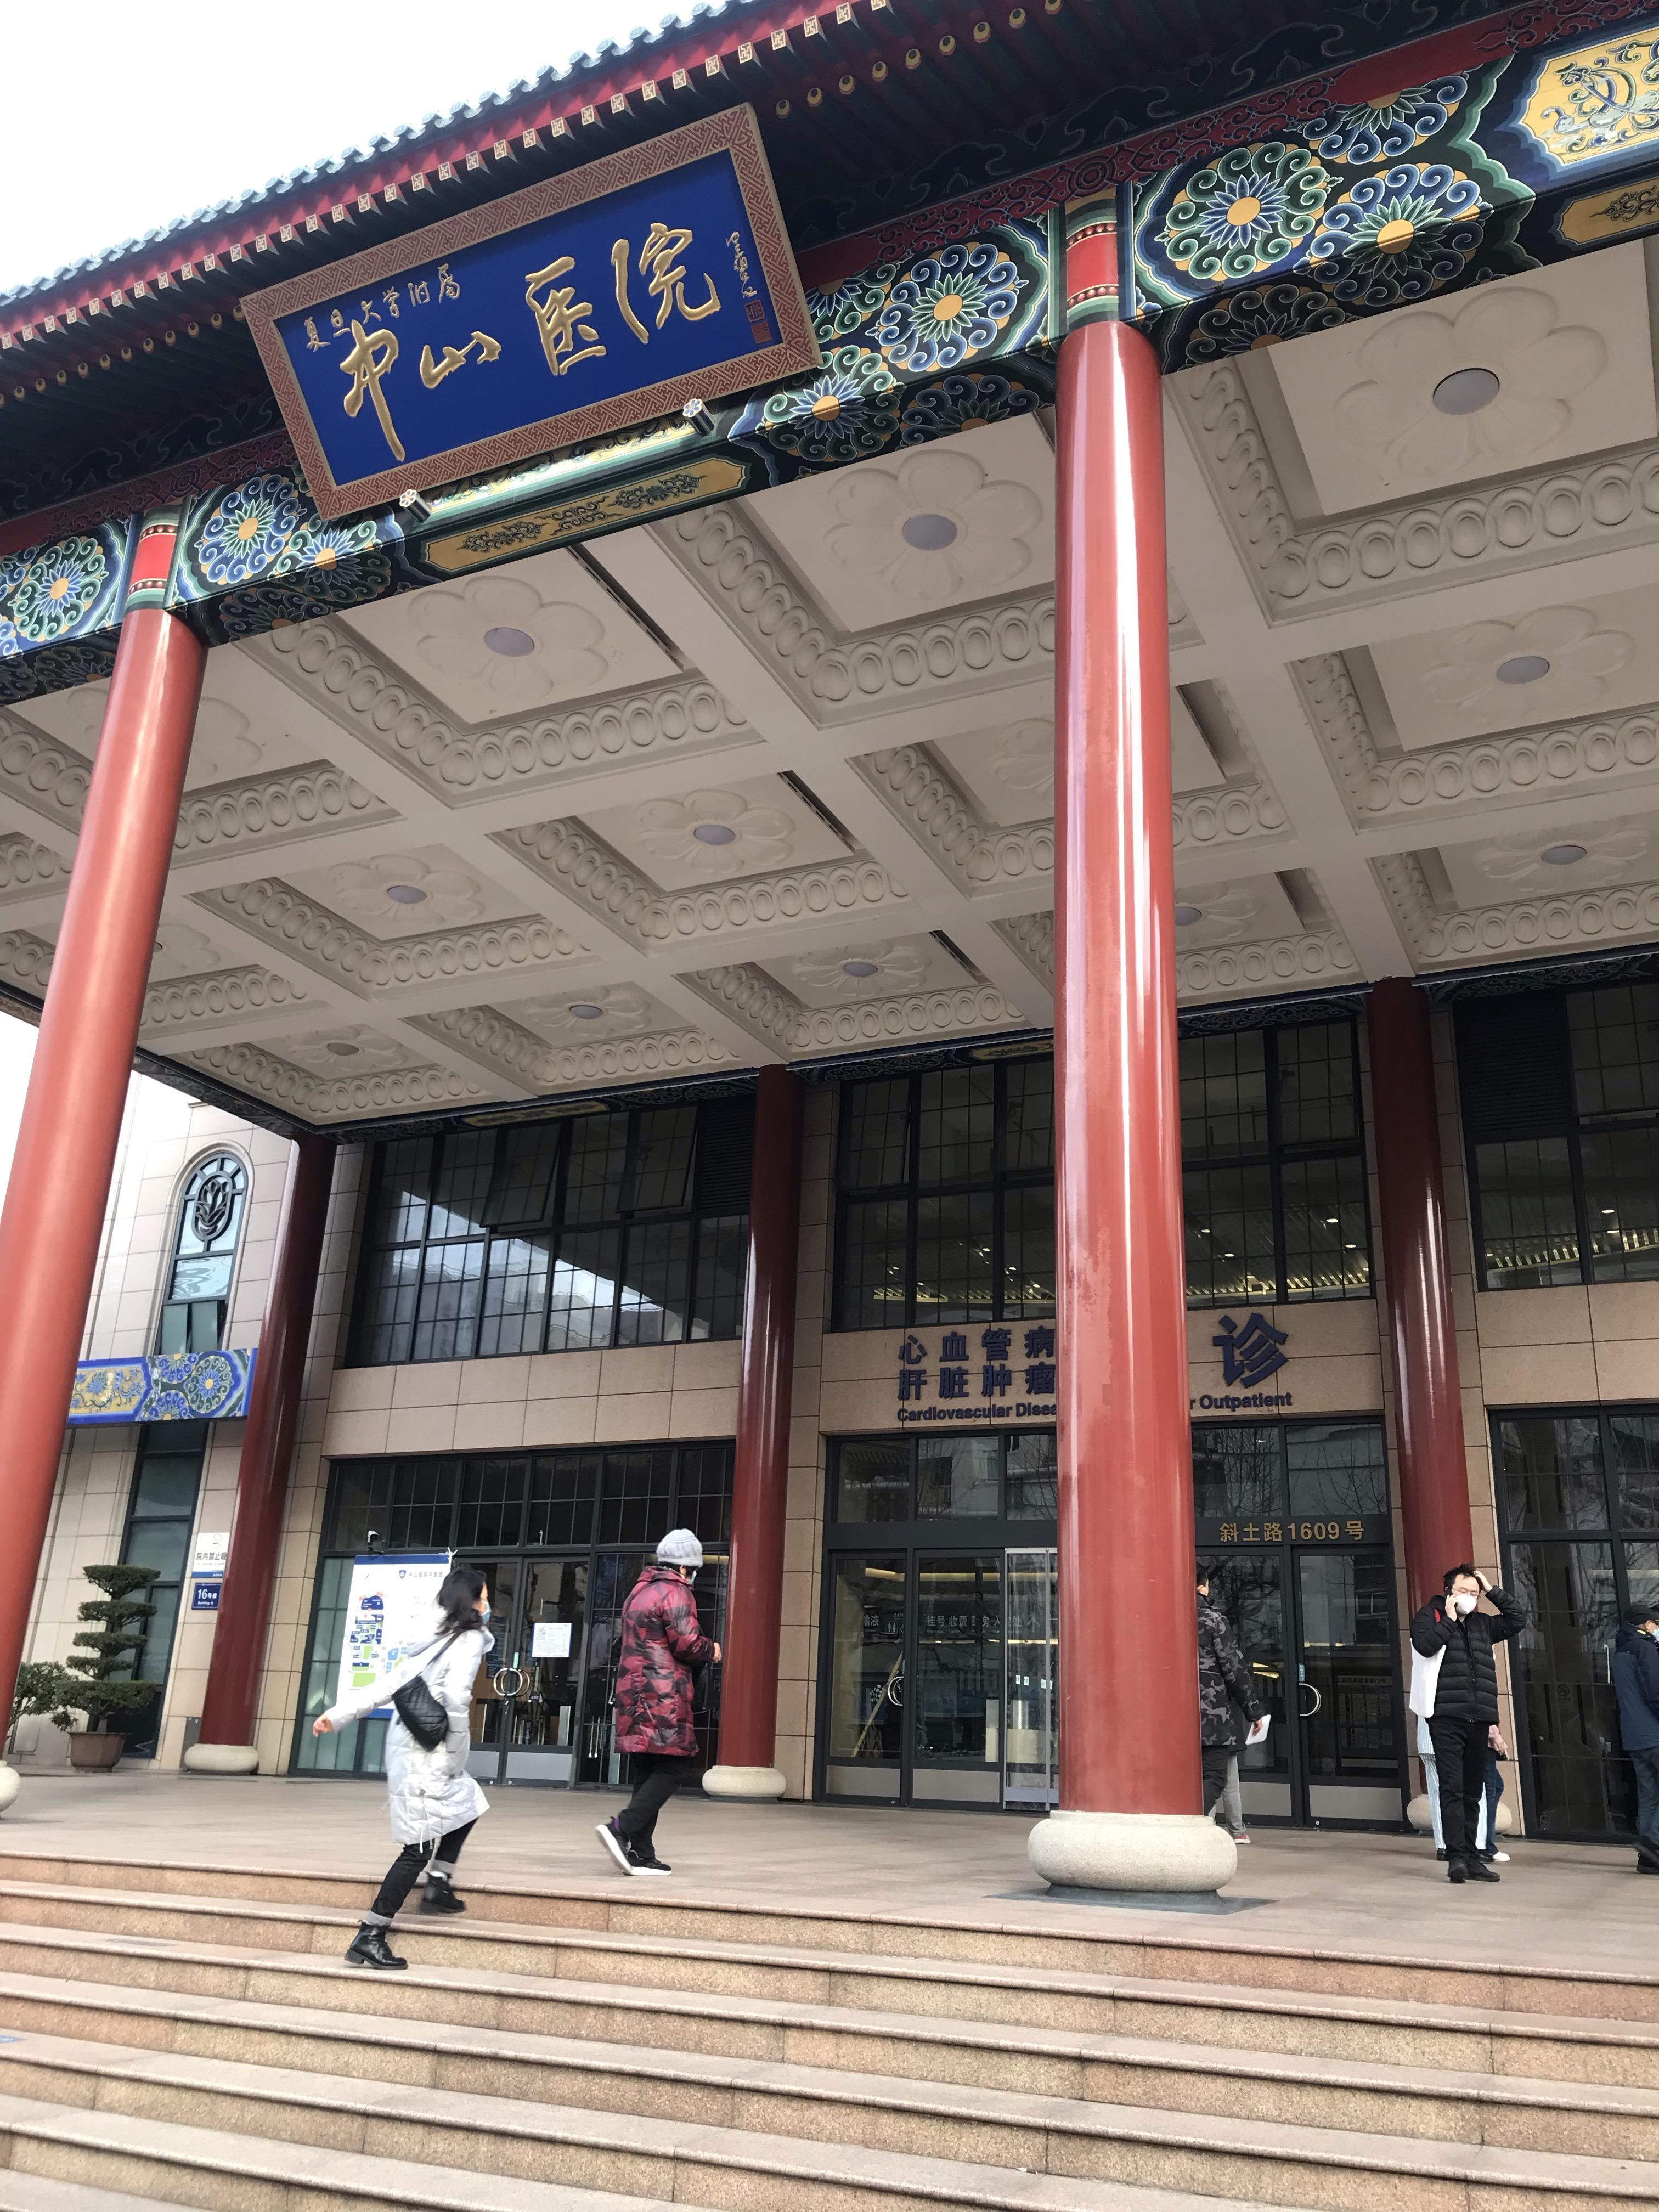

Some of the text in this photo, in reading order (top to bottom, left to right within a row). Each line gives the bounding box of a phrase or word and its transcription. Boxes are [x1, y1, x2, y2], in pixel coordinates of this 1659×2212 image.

[340, 222, 721, 462] 中山医院
[898, 1325, 1055, 1364] 心血管病
[1212, 1312, 1289, 1389] 诊
[898, 1361, 1056, 1400] 肝脏肿瘤
[897, 1404, 1013, 1421] Cardiovascular
[1199, 1392, 1293, 1412] Outpatient
[1220, 1520, 1364, 1542] 斜土路1609号
[927, 1615, 945, 1627] 挂号
[949, 1615, 967, 1627] 收费
